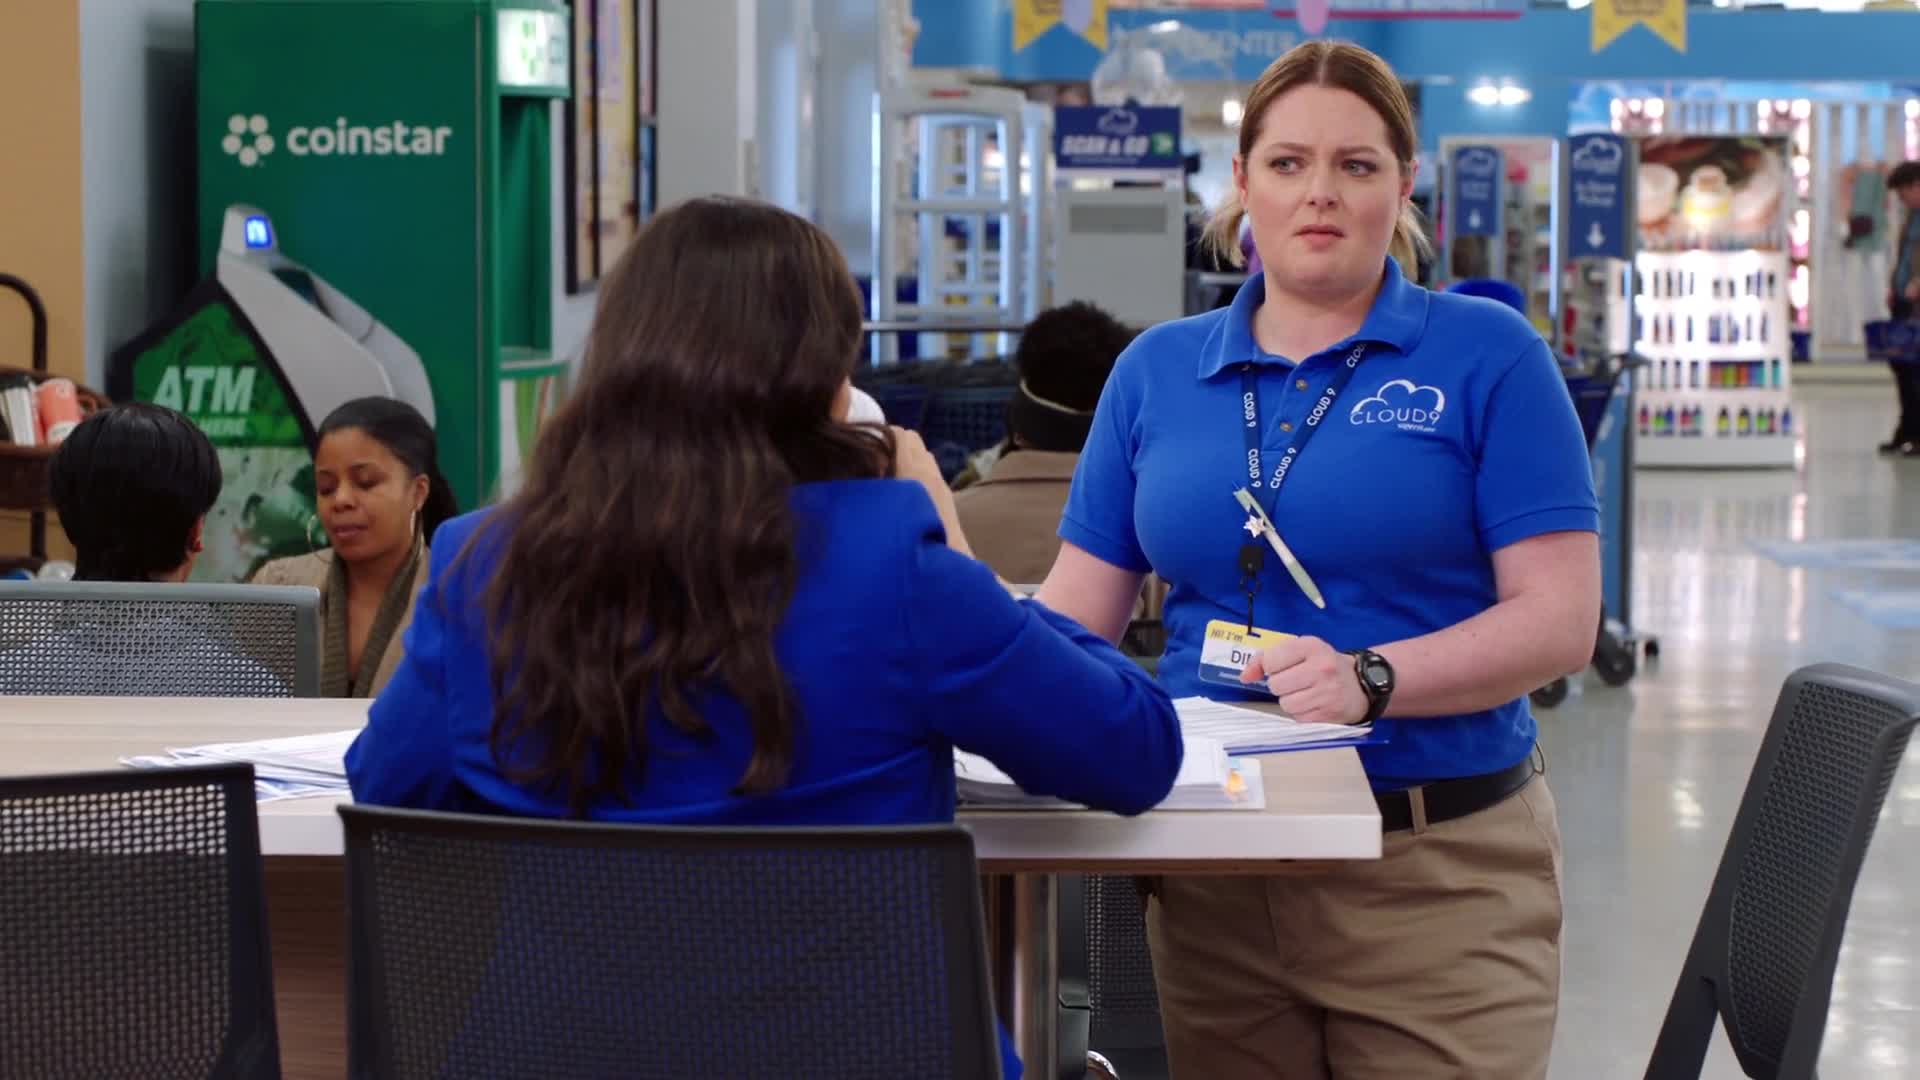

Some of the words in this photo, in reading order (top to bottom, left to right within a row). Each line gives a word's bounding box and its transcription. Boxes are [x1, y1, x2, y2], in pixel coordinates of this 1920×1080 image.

[287, 116, 452, 156] coinstar
[1345, 343, 1367, 368] CLOU
[151, 365, 256, 413] ATM
[1243, 391, 1256, 420] CLOUD
[1306, 396, 1331, 427] CLOUD
[1326, 387, 1336, 397] 9
[1248, 448, 1261, 480] CLOUD
[1269, 455, 1292, 490] CLOUD
[1287, 447, 1297, 456] 9
[1251, 480, 1262, 488] 9
